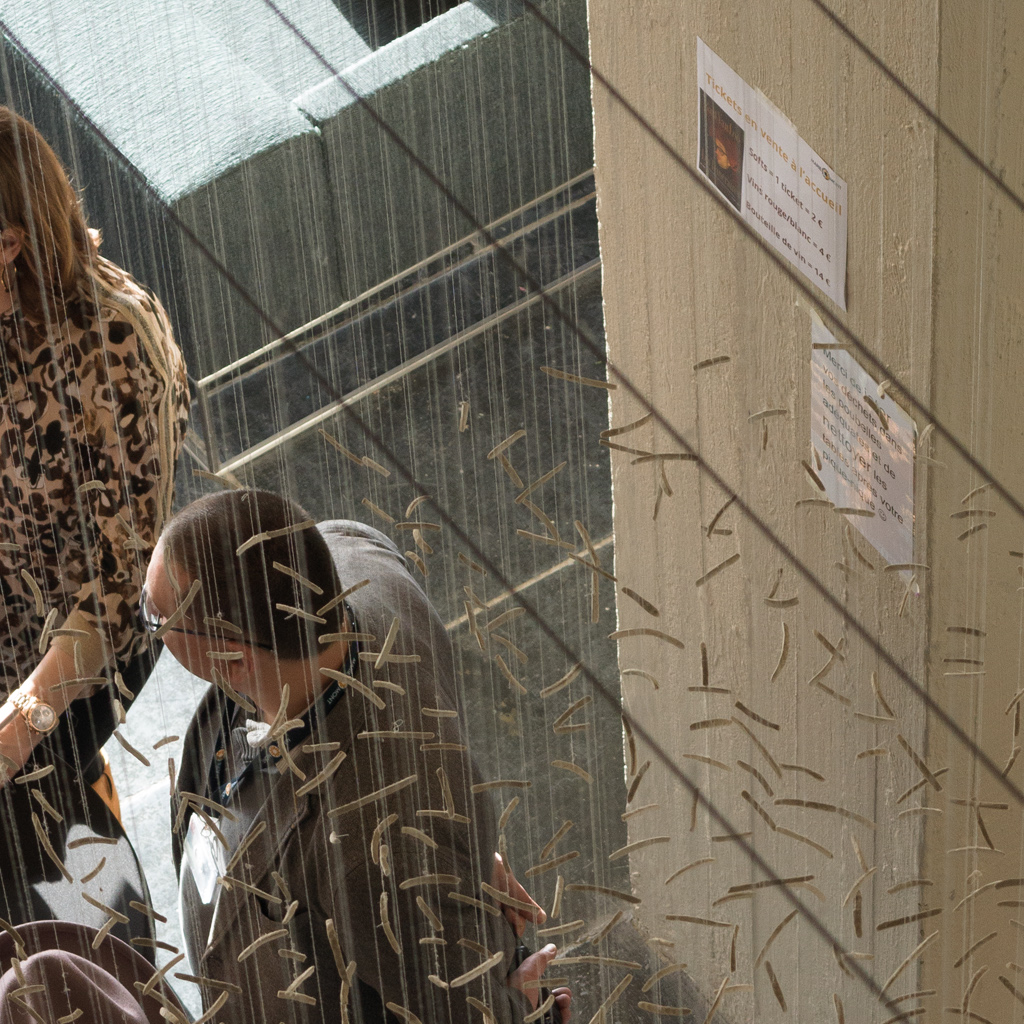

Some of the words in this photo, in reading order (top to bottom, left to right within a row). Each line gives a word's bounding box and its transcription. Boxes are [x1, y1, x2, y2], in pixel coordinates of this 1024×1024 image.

[705, 72, 742, 116] Tickets
[744, 114, 757, 130] en
[760, 127, 788, 162] vente
[791, 155, 797, 172] à
[799, 166, 842, 216] l'accueil
[746, 173, 763, 196] Vins
[764, 193, 812, 244] rouge/blanc
[819, 247, 825, 257] 4
[825, 252, 832, 263] €
[748, 147, 768, 172] Softs
[781, 182, 804, 210] ticket
[811, 212, 817, 223] 2
[817, 218, 824, 229] €
[745, 200, 780, 240] Bouteille
[782, 237, 792, 251] de
[793, 248, 806, 265] vin
[814, 267, 824, 283] 14
[826, 277, 831, 287] €
[822, 365, 838, 387] vos
[840, 385, 878, 429] déchets
[879, 422, 903, 455] dans
[823, 349, 848, 379] Merci
[850, 376, 862, 394] de
[822, 379, 836, 400] les
[838, 397, 882, 450] poubelles
[822, 396, 870, 453] adéquates
[872, 450, 882, 465] et
[883, 461, 896, 480] de
[822, 415, 871, 472] nettoyer
[873, 469, 888, 491] les
[822, 433, 850, 468] tables
[851, 464, 878, 498] après
[879, 493, 904, 525] votre
[822, 449, 876, 511] pique-nique
